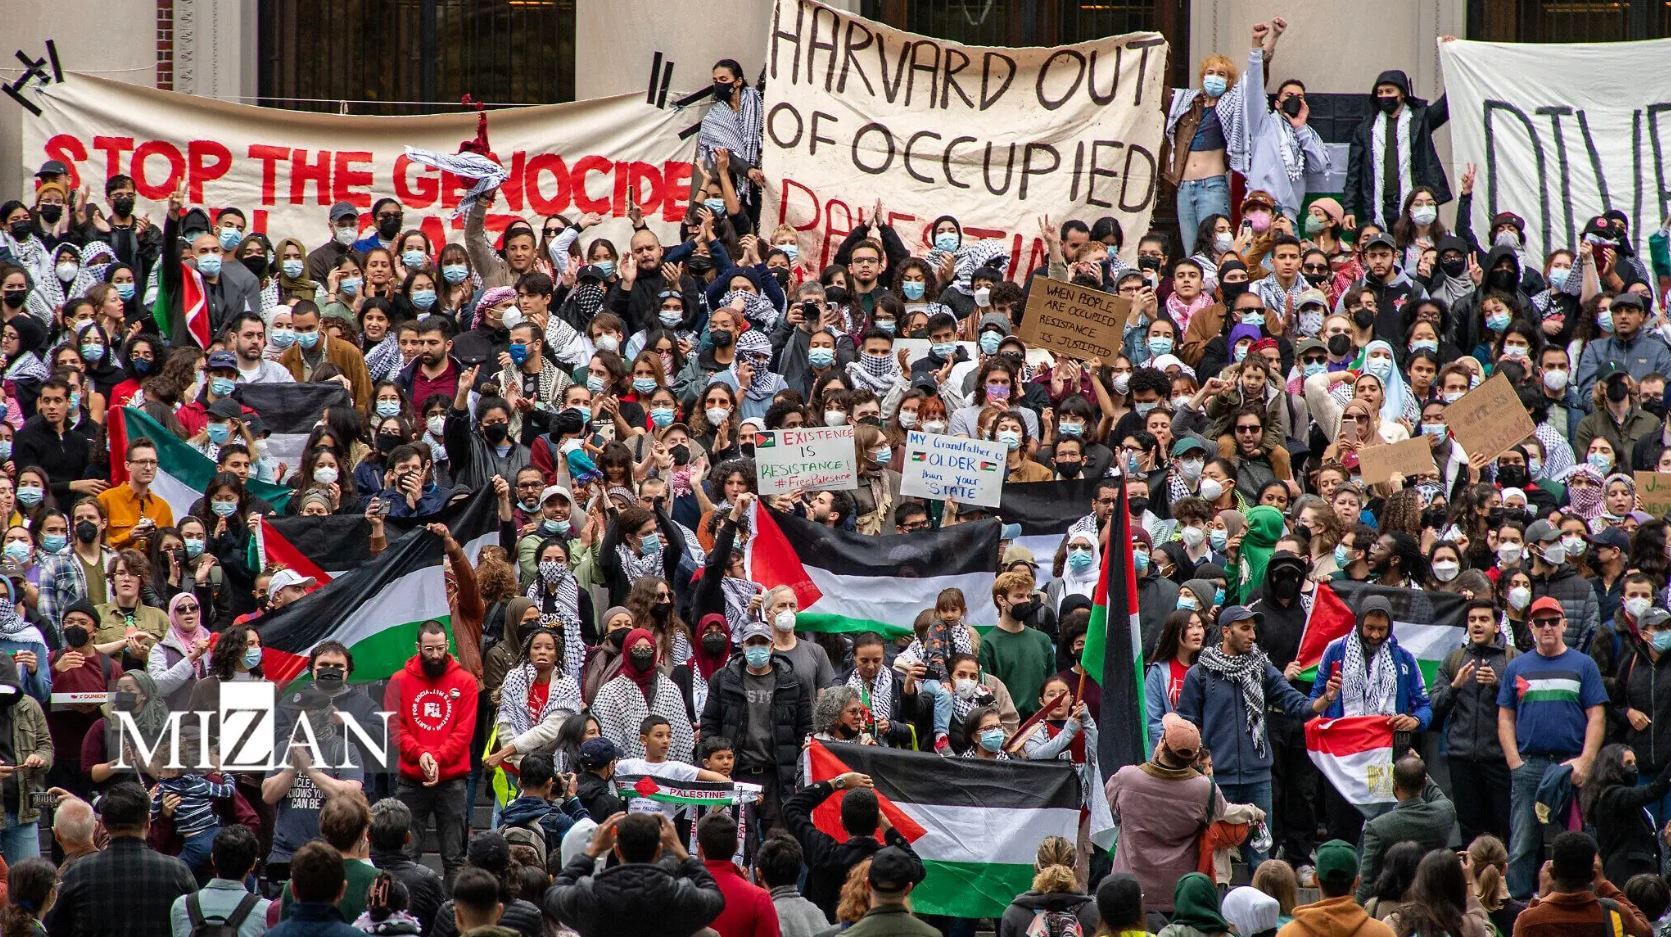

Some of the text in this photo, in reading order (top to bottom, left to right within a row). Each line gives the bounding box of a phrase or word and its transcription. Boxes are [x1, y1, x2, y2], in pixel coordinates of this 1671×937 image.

[770, 0, 1166, 111] HARVARD OUT
[767, 102, 1157, 213] OF OCCUPIED
[35, 133, 233, 204] STOP
[249, 144, 374, 208] THE
[1047, 284, 1115, 314] WHEN PEOPLE
[1039, 314, 1097, 339] RESISTANCE
[1044, 300, 1116, 328] ARE OCCUPIED
[1039, 331, 1112, 357] IS JUSTIFIED
[783, 428, 854, 446] EXISTENCE
[910, 433, 927, 446] MY
[800, 445, 816, 458] IS
[929, 453, 977, 472] OLDER
[291, 798, 320, 809] CAN BE
[669, 787, 726, 799] PALESTINE
